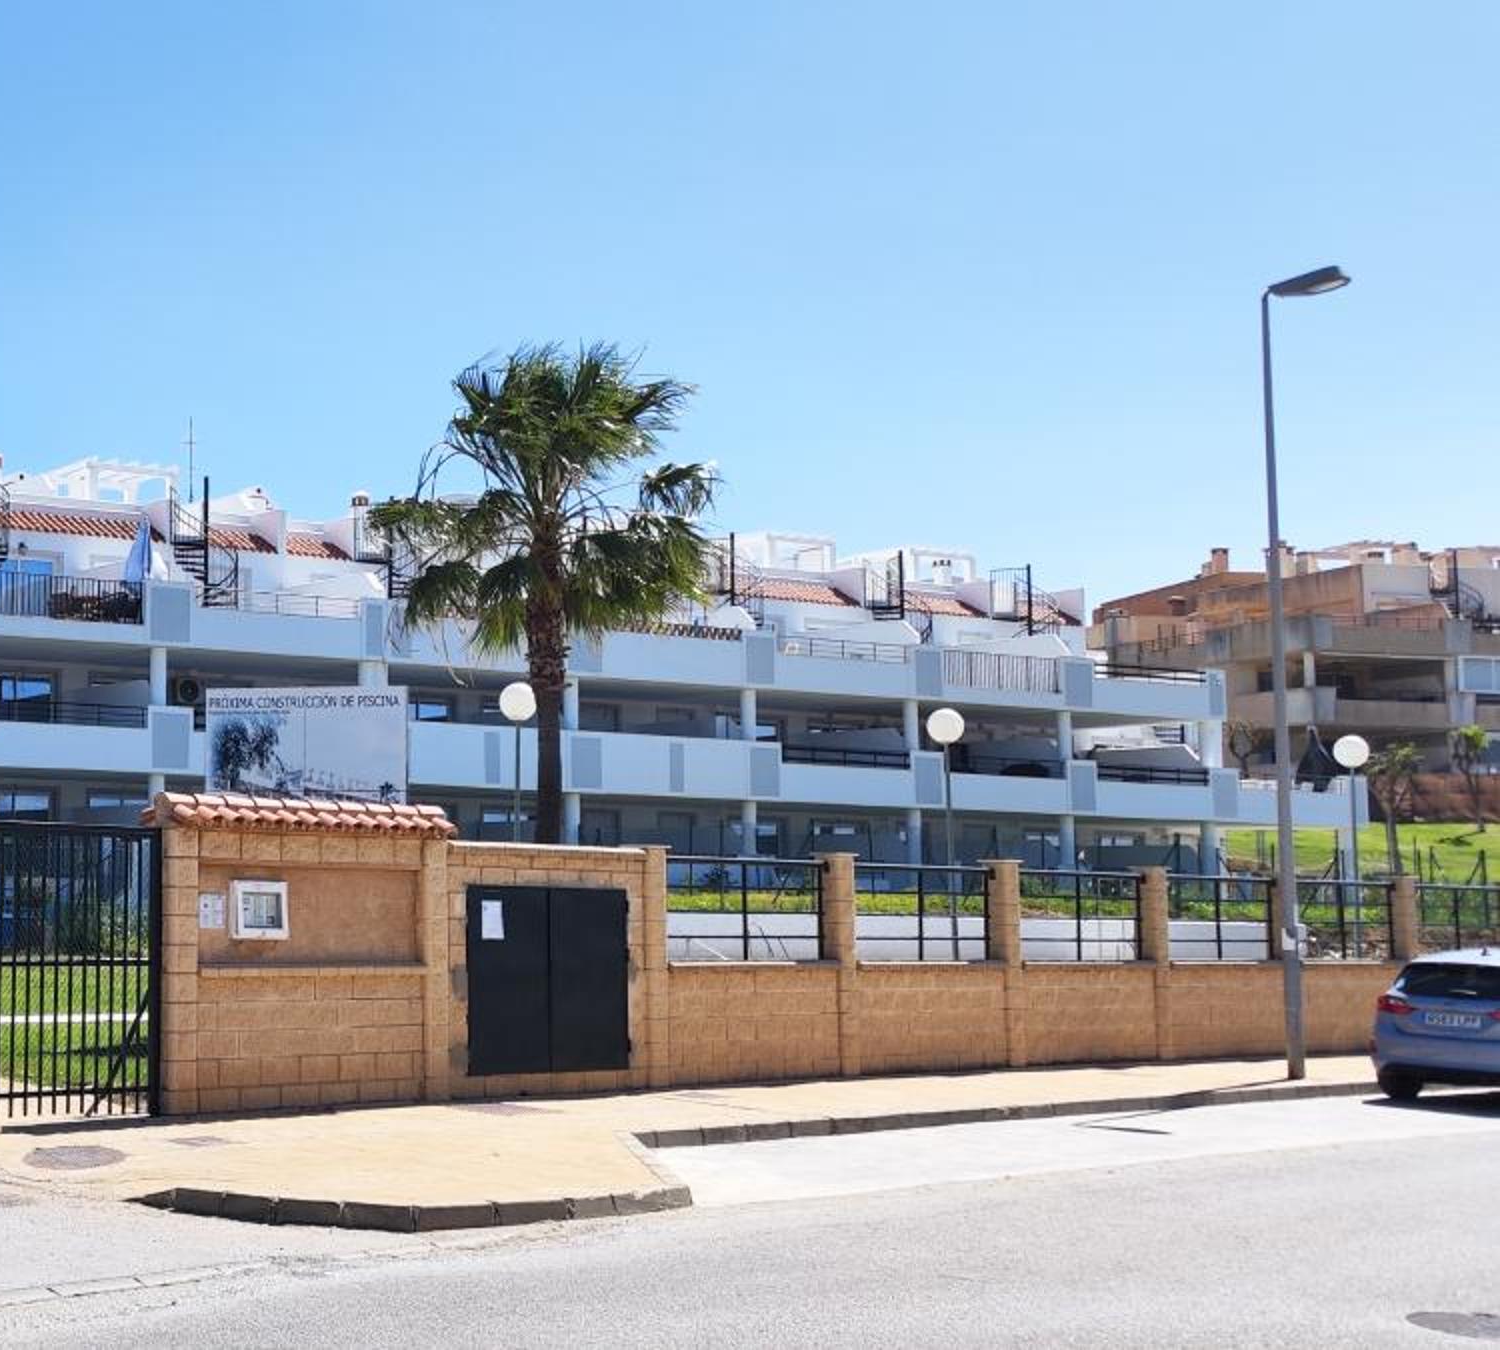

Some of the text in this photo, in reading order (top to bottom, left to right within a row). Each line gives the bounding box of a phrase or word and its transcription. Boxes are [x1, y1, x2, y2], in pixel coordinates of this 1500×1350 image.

[209, 693, 399, 708] PRÓXIMA CONSTRUCCIÓN DE PISCINA
